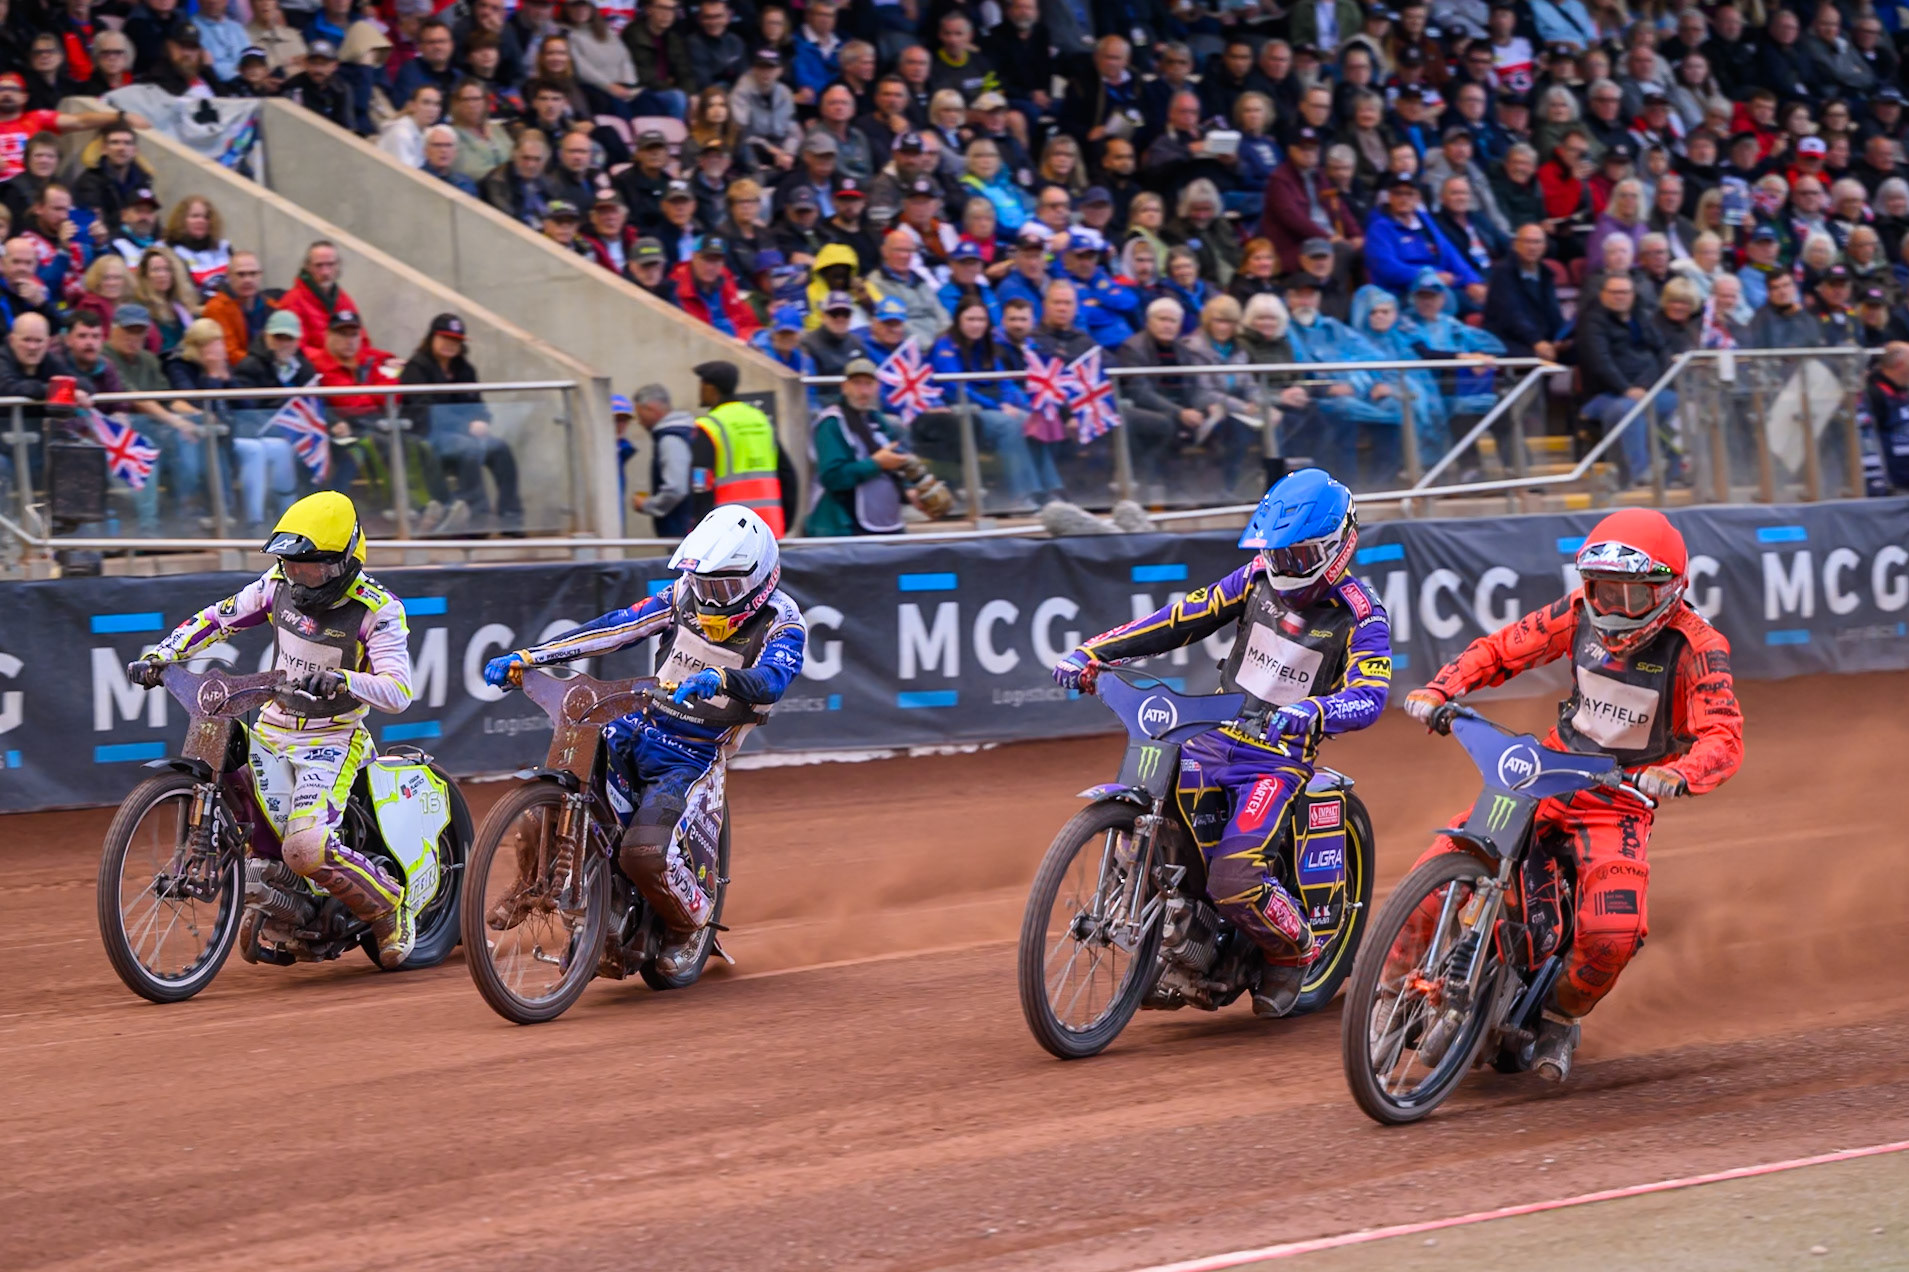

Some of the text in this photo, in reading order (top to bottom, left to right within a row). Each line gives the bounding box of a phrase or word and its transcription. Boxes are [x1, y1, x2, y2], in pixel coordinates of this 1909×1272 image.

[1762, 545, 1908, 620] MCG
[752, 581, 774, 610] Red
[898, 596, 1082, 679] MCG
[1248, 647, 1309, 683] MAYFIELD
[1636, 662, 1664, 674] SGP
[660, 705, 680, 719] ROBERT
[680, 712, 705, 725] LAMBERT
[1144, 709, 1170, 724] ATPI
[1581, 693, 1649, 724] AYFIELD
[1504, 756, 1533, 776] ATPI
[419, 791, 441, 814] 16
[1307, 848, 1343, 870] LIGRA
